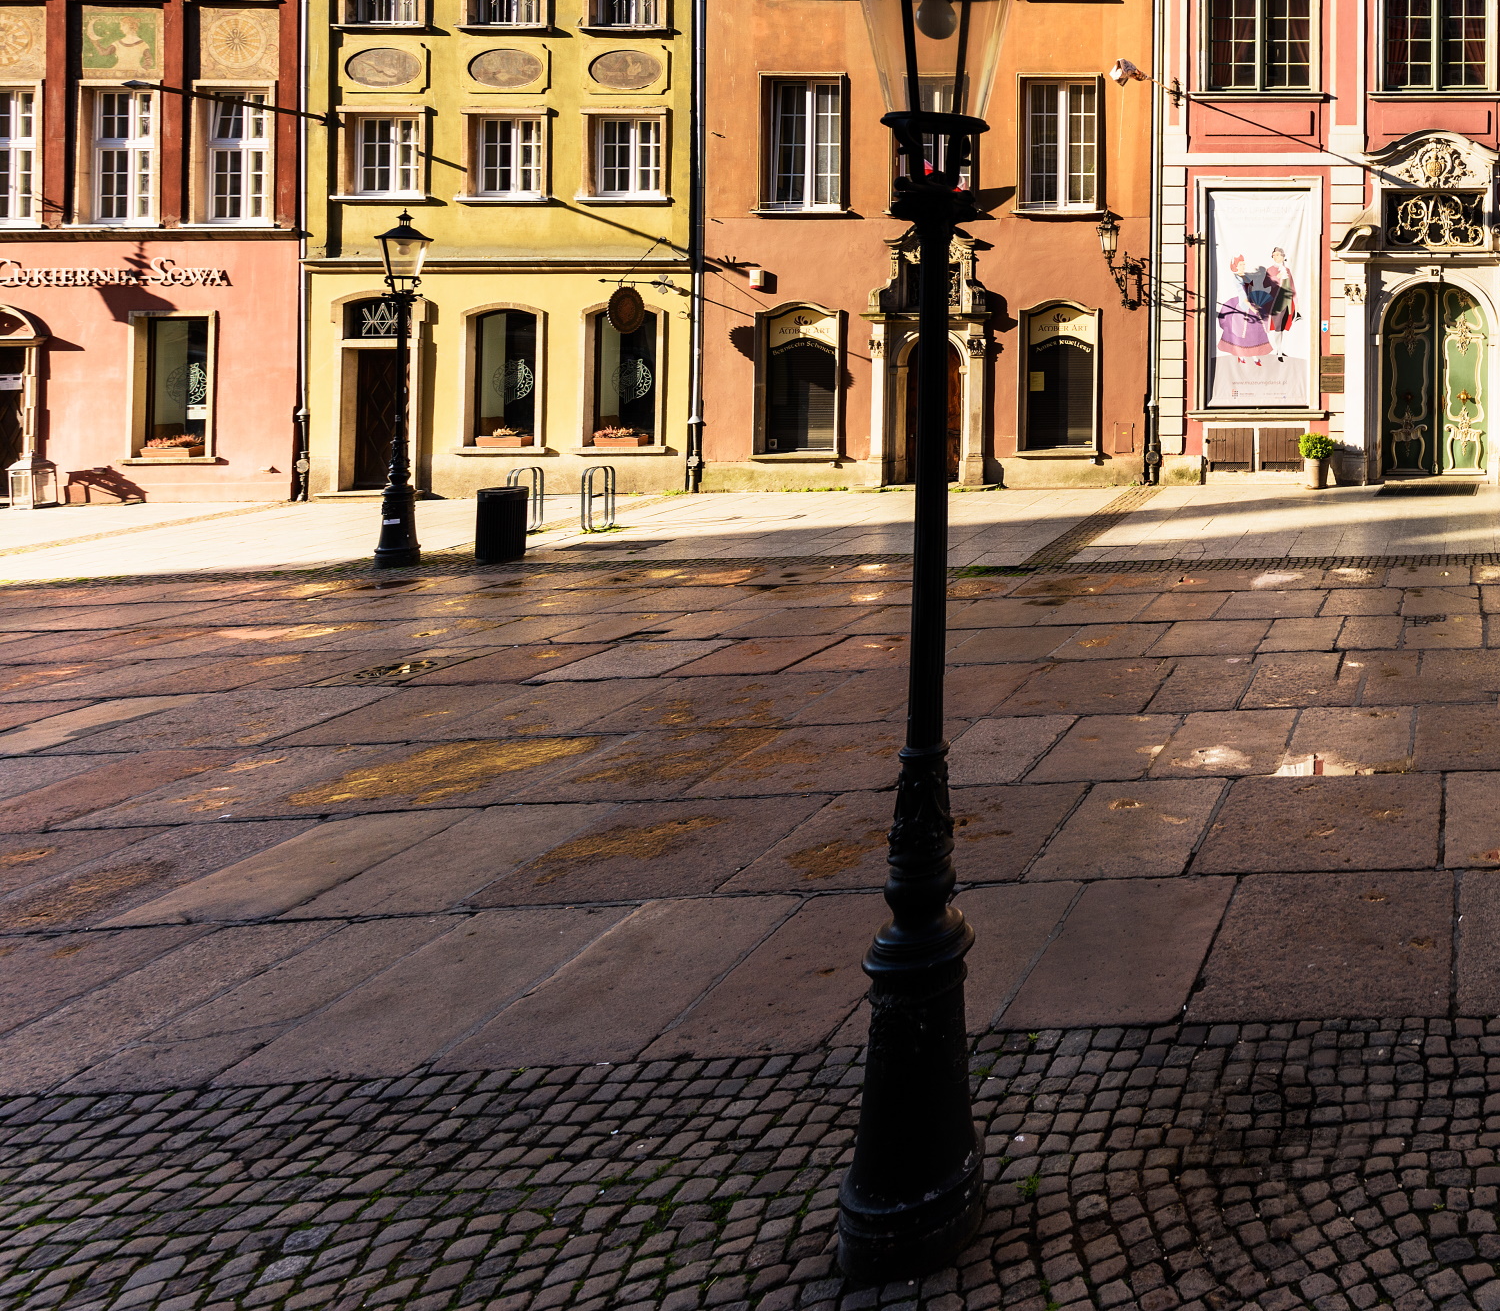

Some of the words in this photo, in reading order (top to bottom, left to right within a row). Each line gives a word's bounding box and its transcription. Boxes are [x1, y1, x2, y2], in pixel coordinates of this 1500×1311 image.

[150, 256, 223, 285] SOWA
[1038, 324, 1069, 332] AMBER
[1071, 324, 1088, 332] ART
